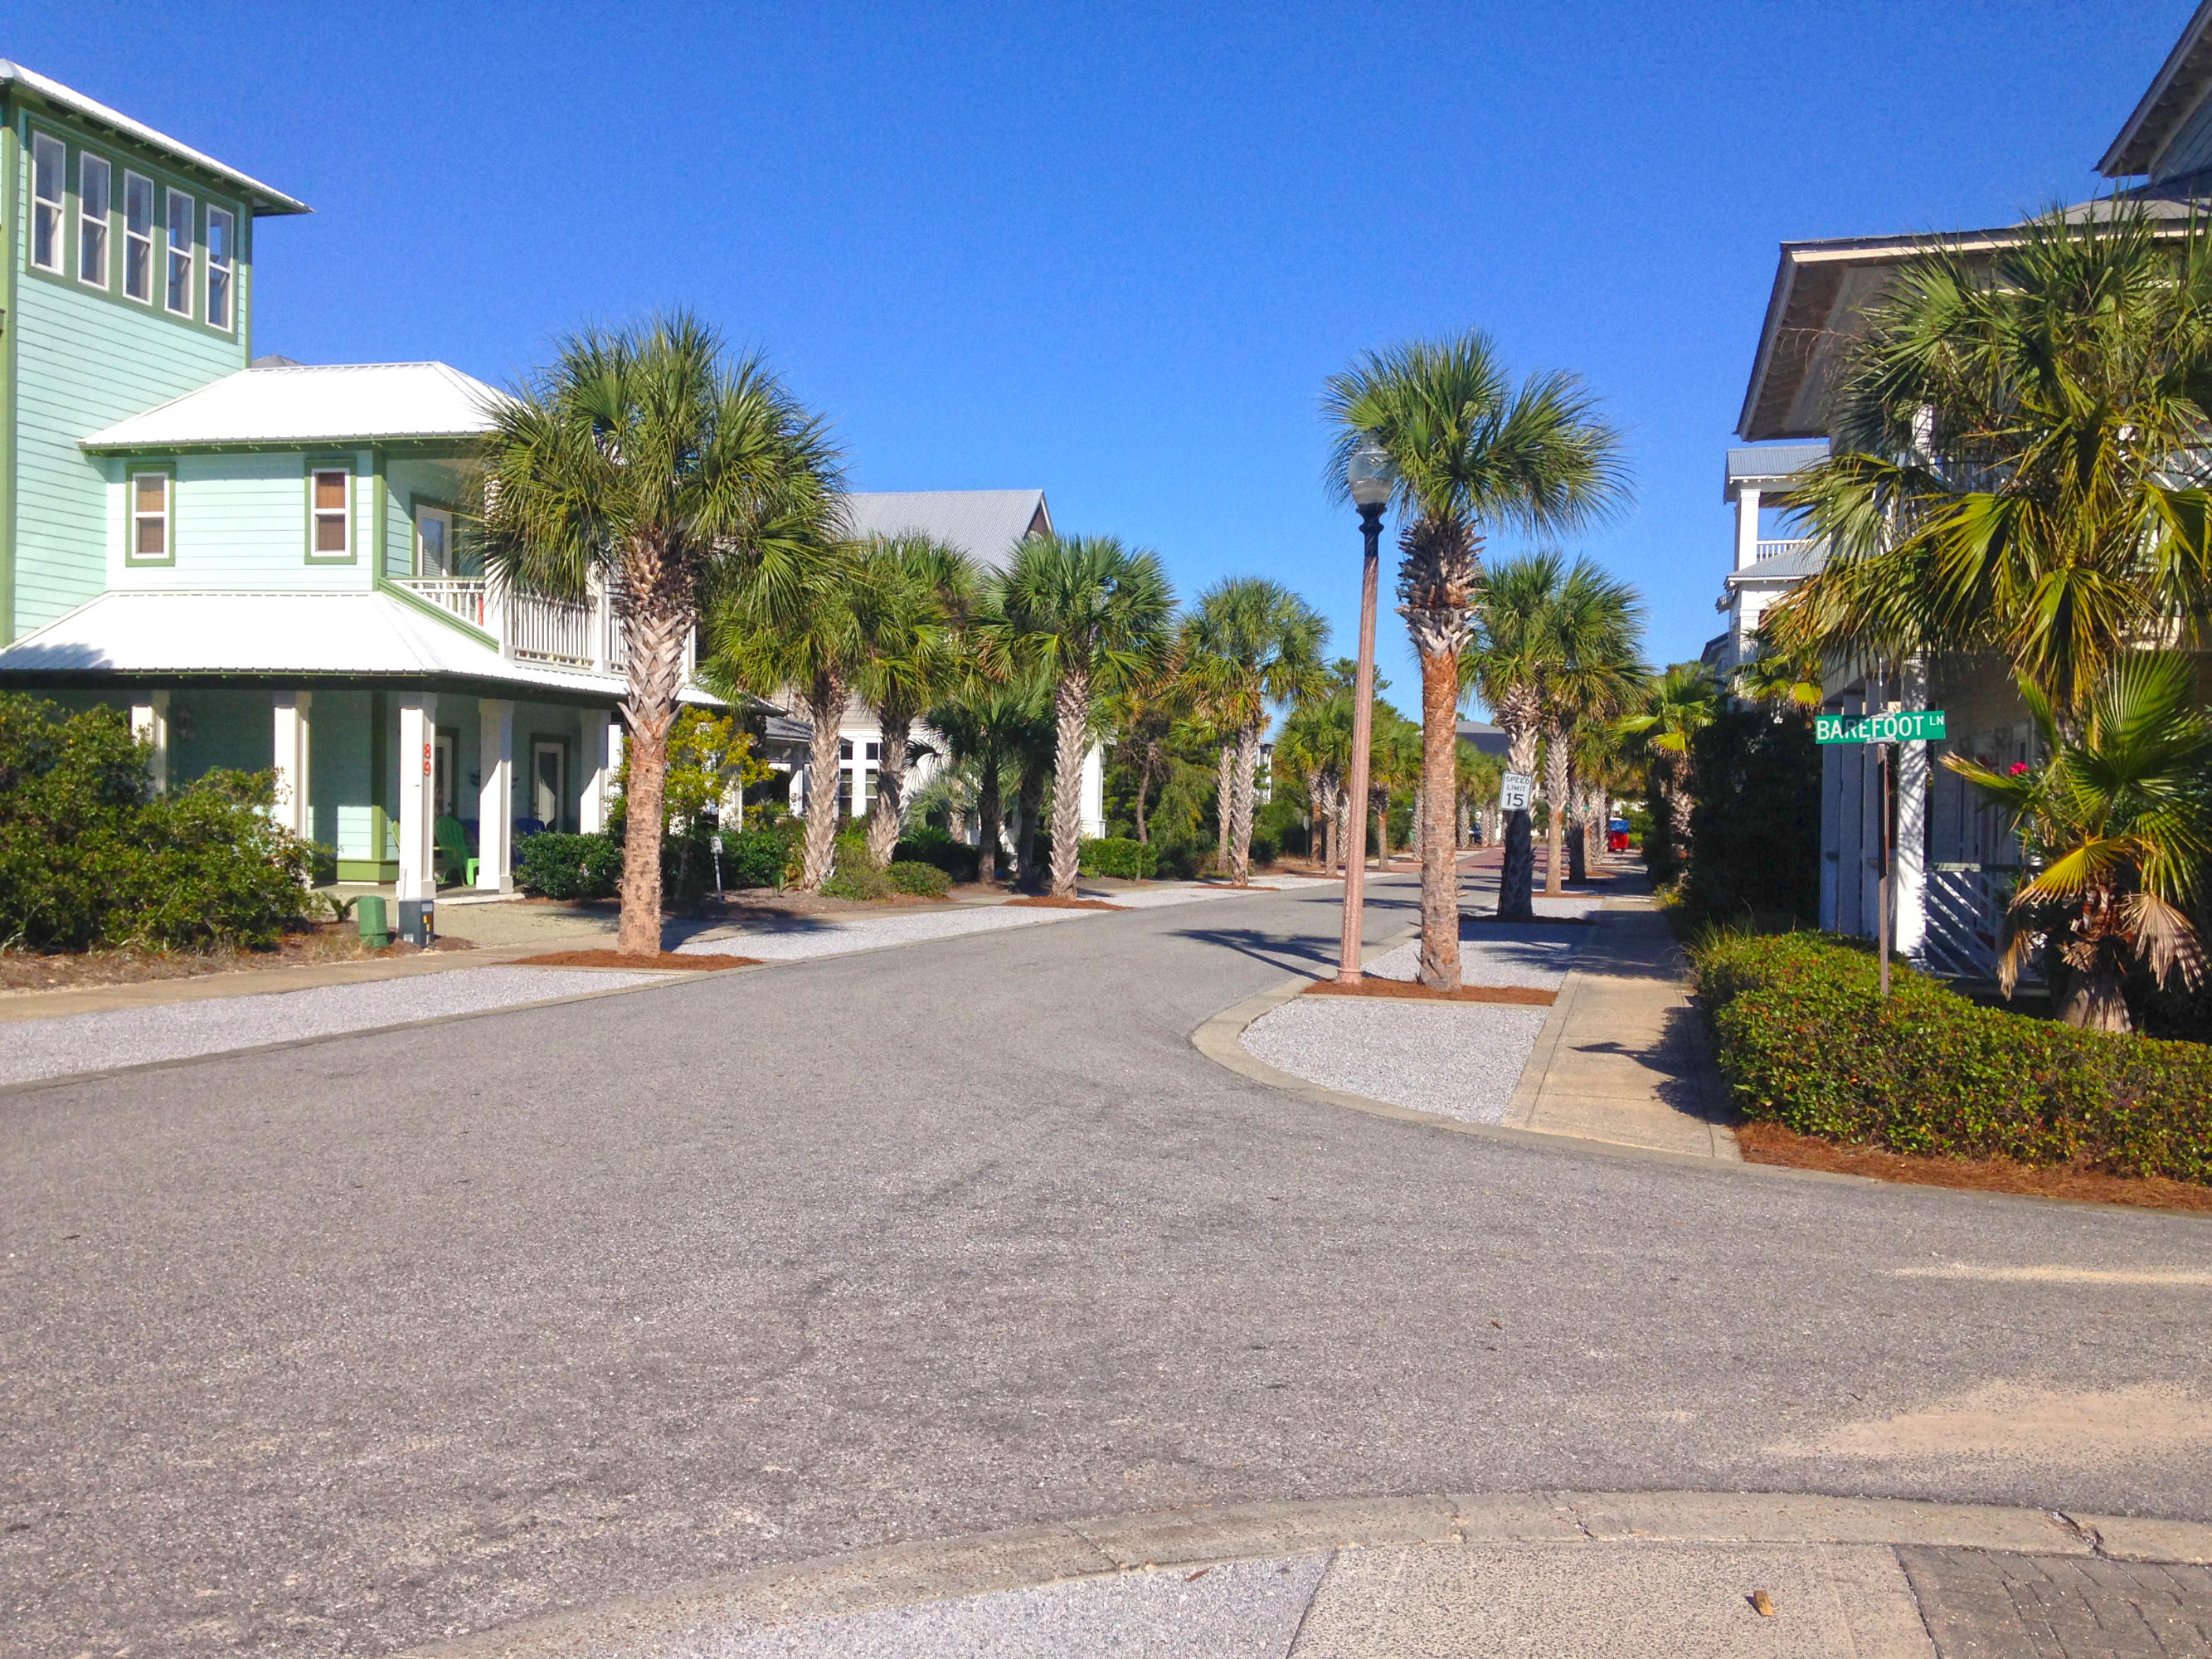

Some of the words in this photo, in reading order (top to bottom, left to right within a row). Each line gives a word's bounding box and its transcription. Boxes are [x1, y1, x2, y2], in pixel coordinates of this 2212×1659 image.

[1816, 716, 1924, 740] BAREFOOT
[1929, 715, 1944, 726] LN
[424, 743, 431, 776] 89
[1507, 793, 1524, 806] 15
